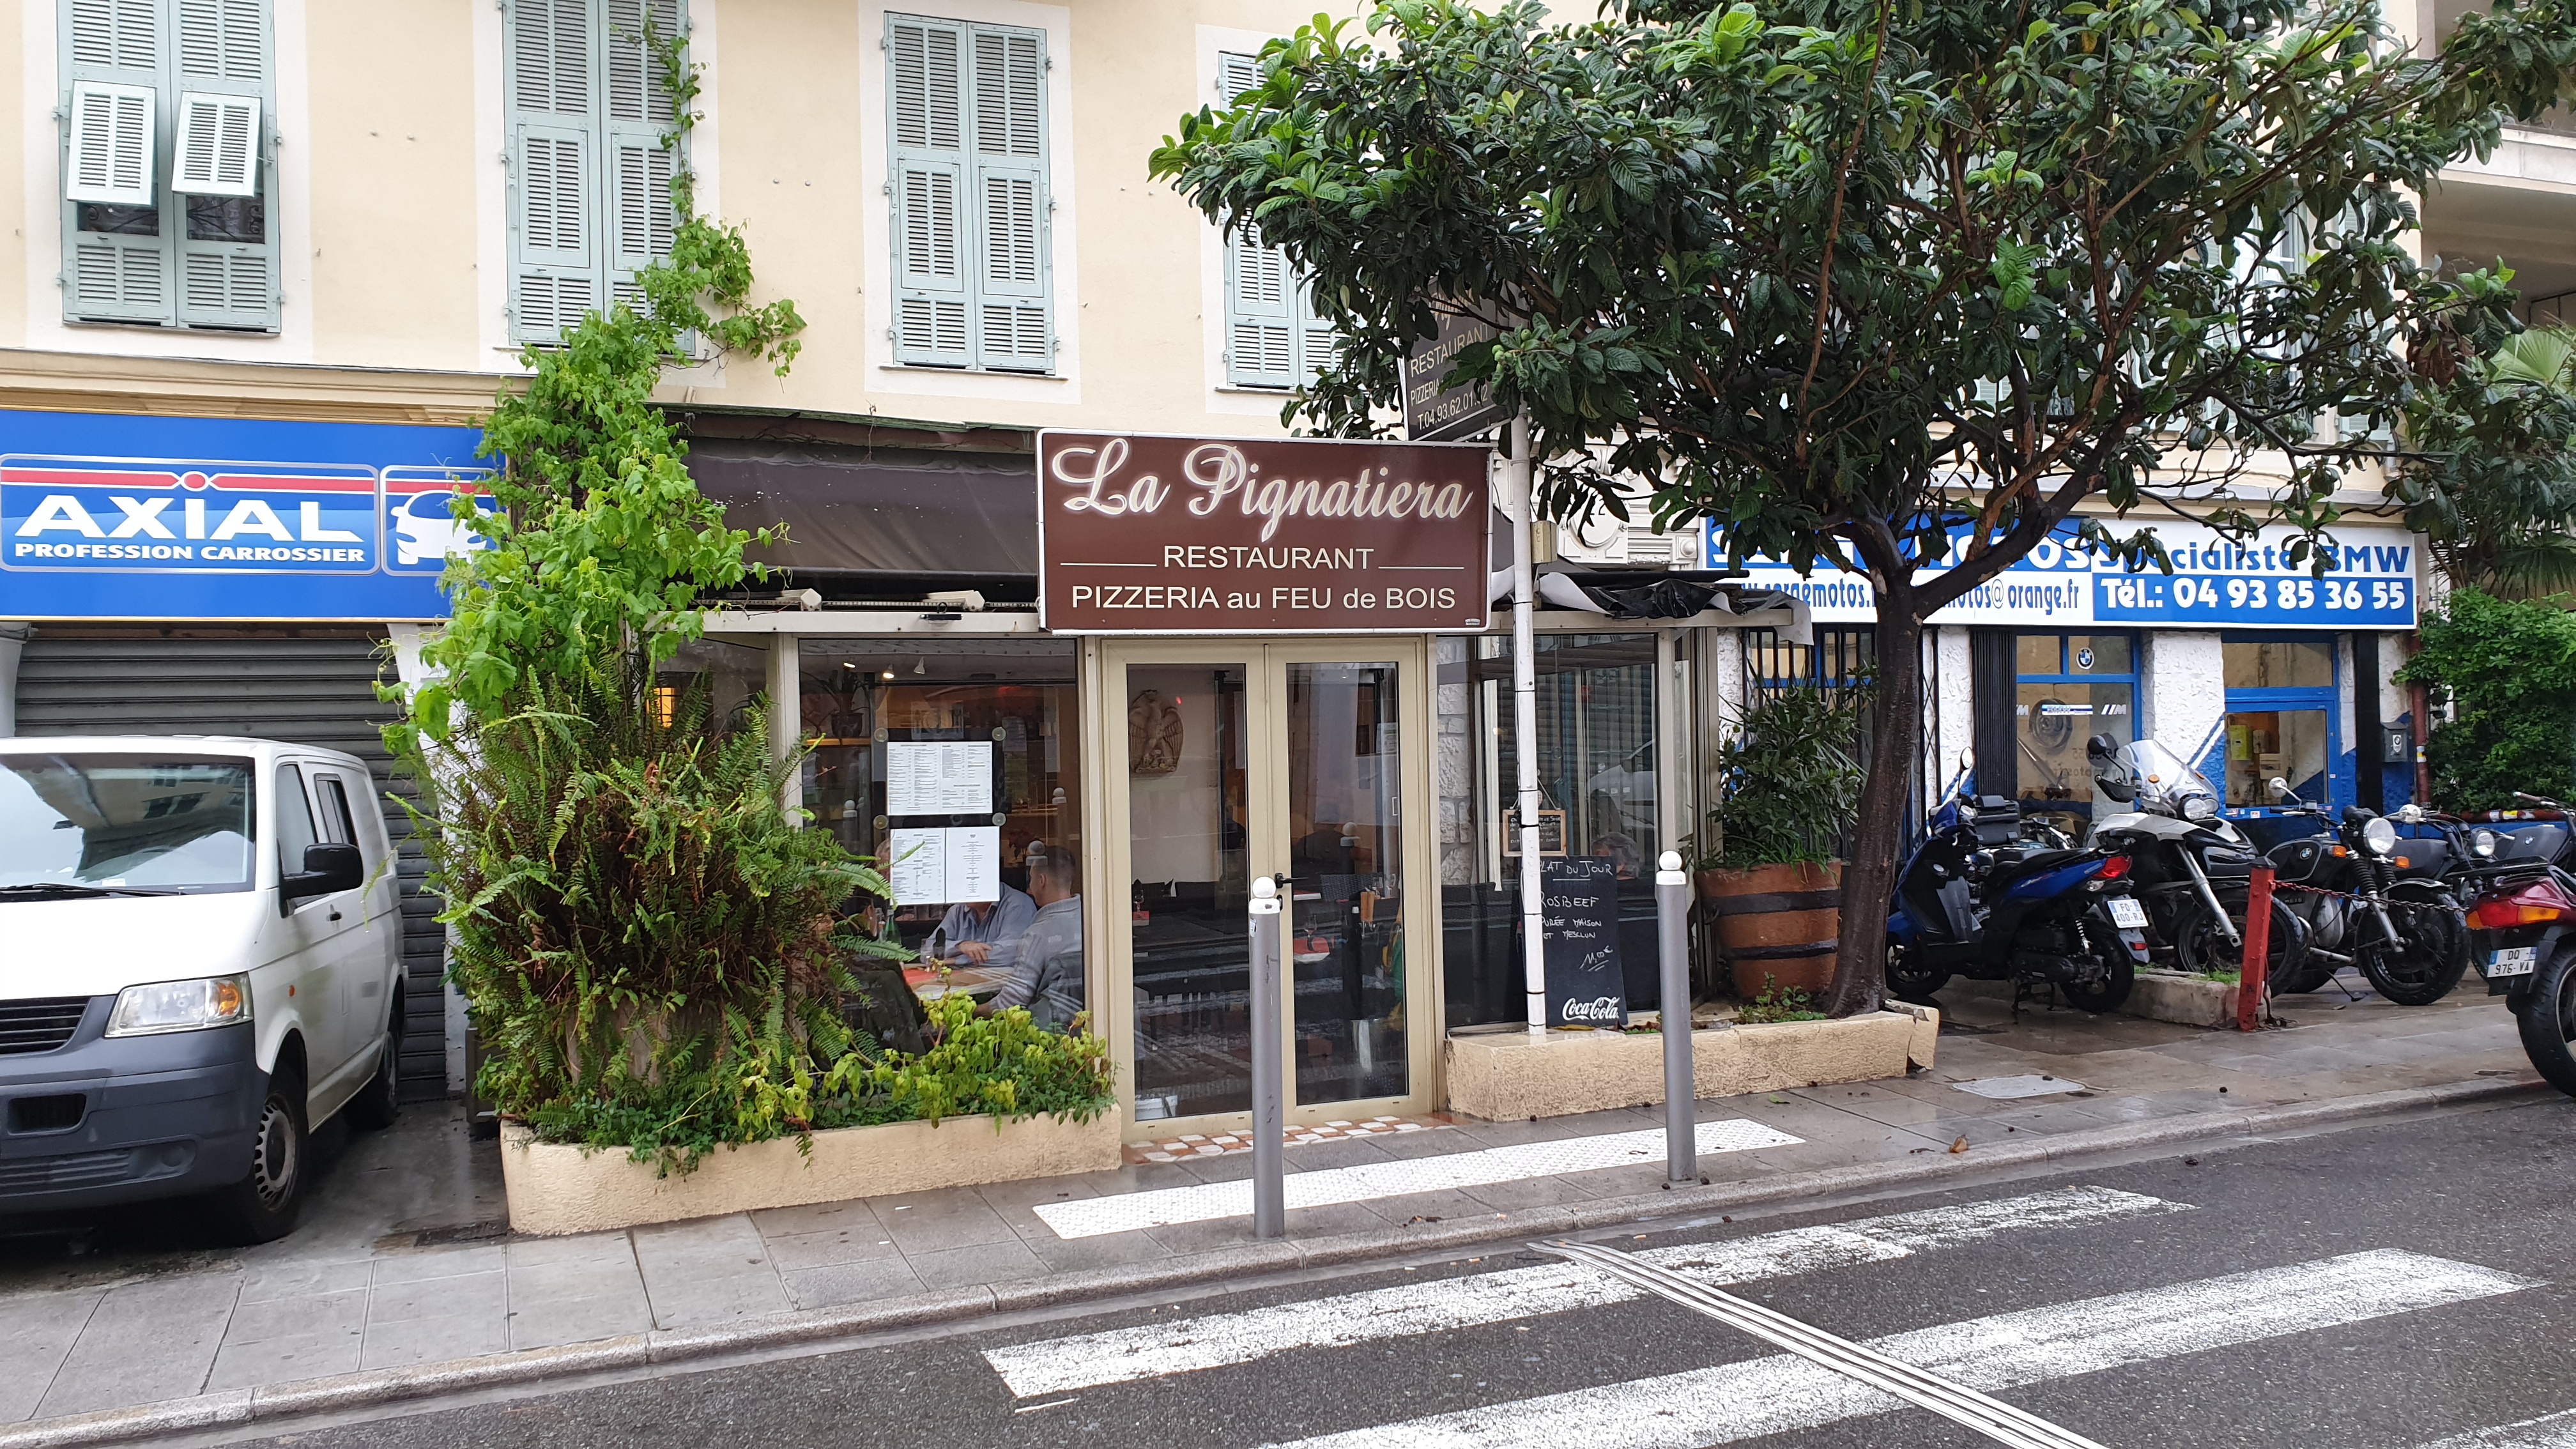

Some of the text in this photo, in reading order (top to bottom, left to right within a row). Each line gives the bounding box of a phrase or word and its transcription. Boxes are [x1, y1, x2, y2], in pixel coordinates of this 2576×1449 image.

[1411, 378, 1440, 406] PIZZERIA
[1418, 385, 1488, 430] T.04.93.62.01.2
[1052, 438, 1473, 542] La Pignatiera
[14, 494, 364, 542] AXIAL
[15, 542, 365, 563] PROFESSION CARROSSIER
[1164, 546, 1374, 569] RESTAURANT
[1073, 585, 1456, 610] PIZZERIA au FEU de BOIS
[2174, 578, 2218, 609] 04
[2227, 578, 2267, 608] 93
[2277, 579, 2315, 610] 85
[2324, 581, 2363, 610] 36
[2372, 581, 2405, 610] 55
[1566, 865, 1579, 874] DU
[1579, 861, 1613, 877] JOUR
[1562, 930, 1596, 940] MESCLUN
[1562, 997, 1620, 1020] Coca-Cola
